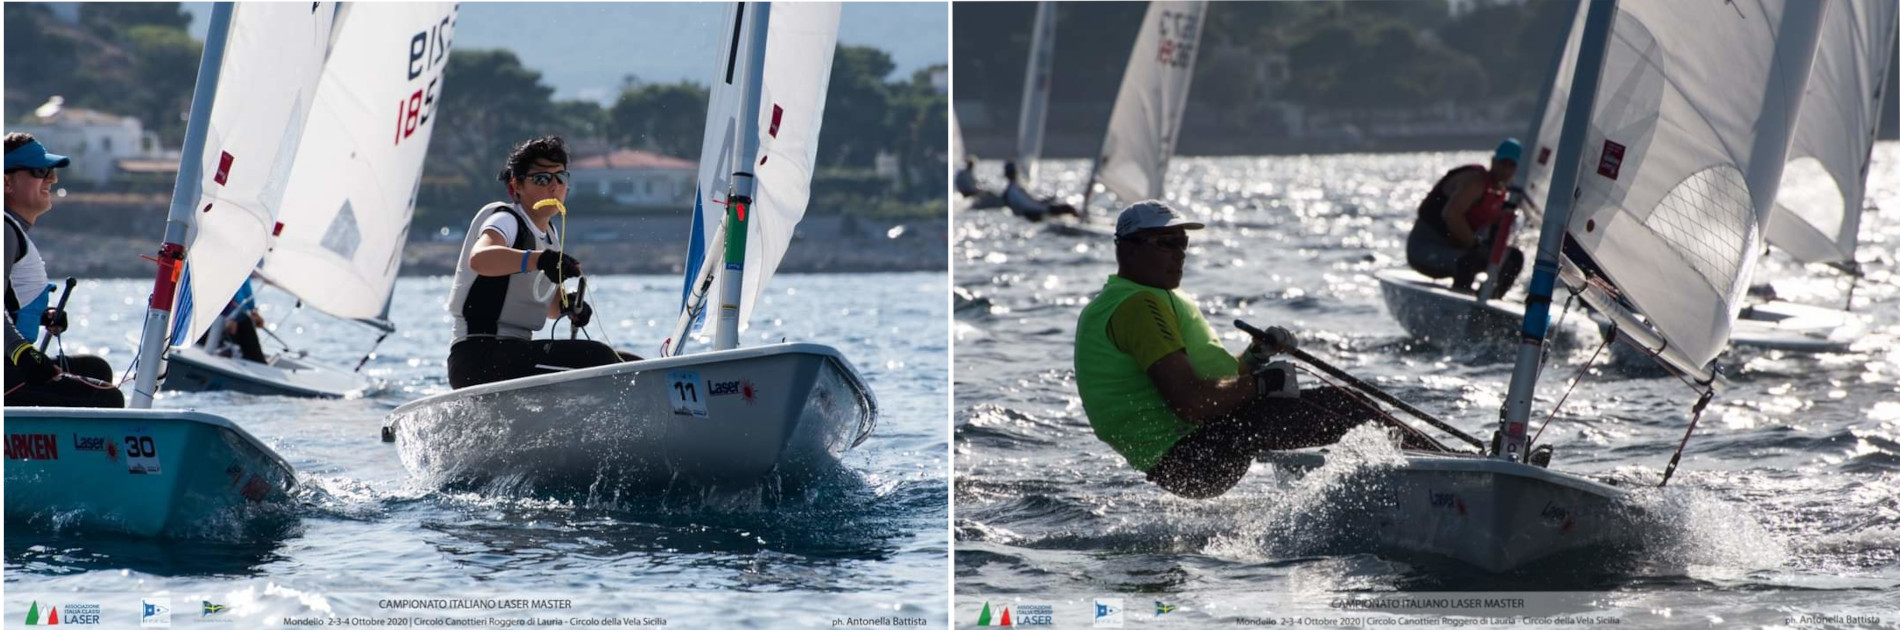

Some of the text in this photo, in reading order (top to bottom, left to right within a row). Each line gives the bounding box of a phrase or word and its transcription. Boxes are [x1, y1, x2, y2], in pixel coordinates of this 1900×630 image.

[674, 381, 698, 402] 11
[707, 380, 741, 395] Laser
[73, 432, 105, 450] Laser
[124, 435, 156, 457] 30
